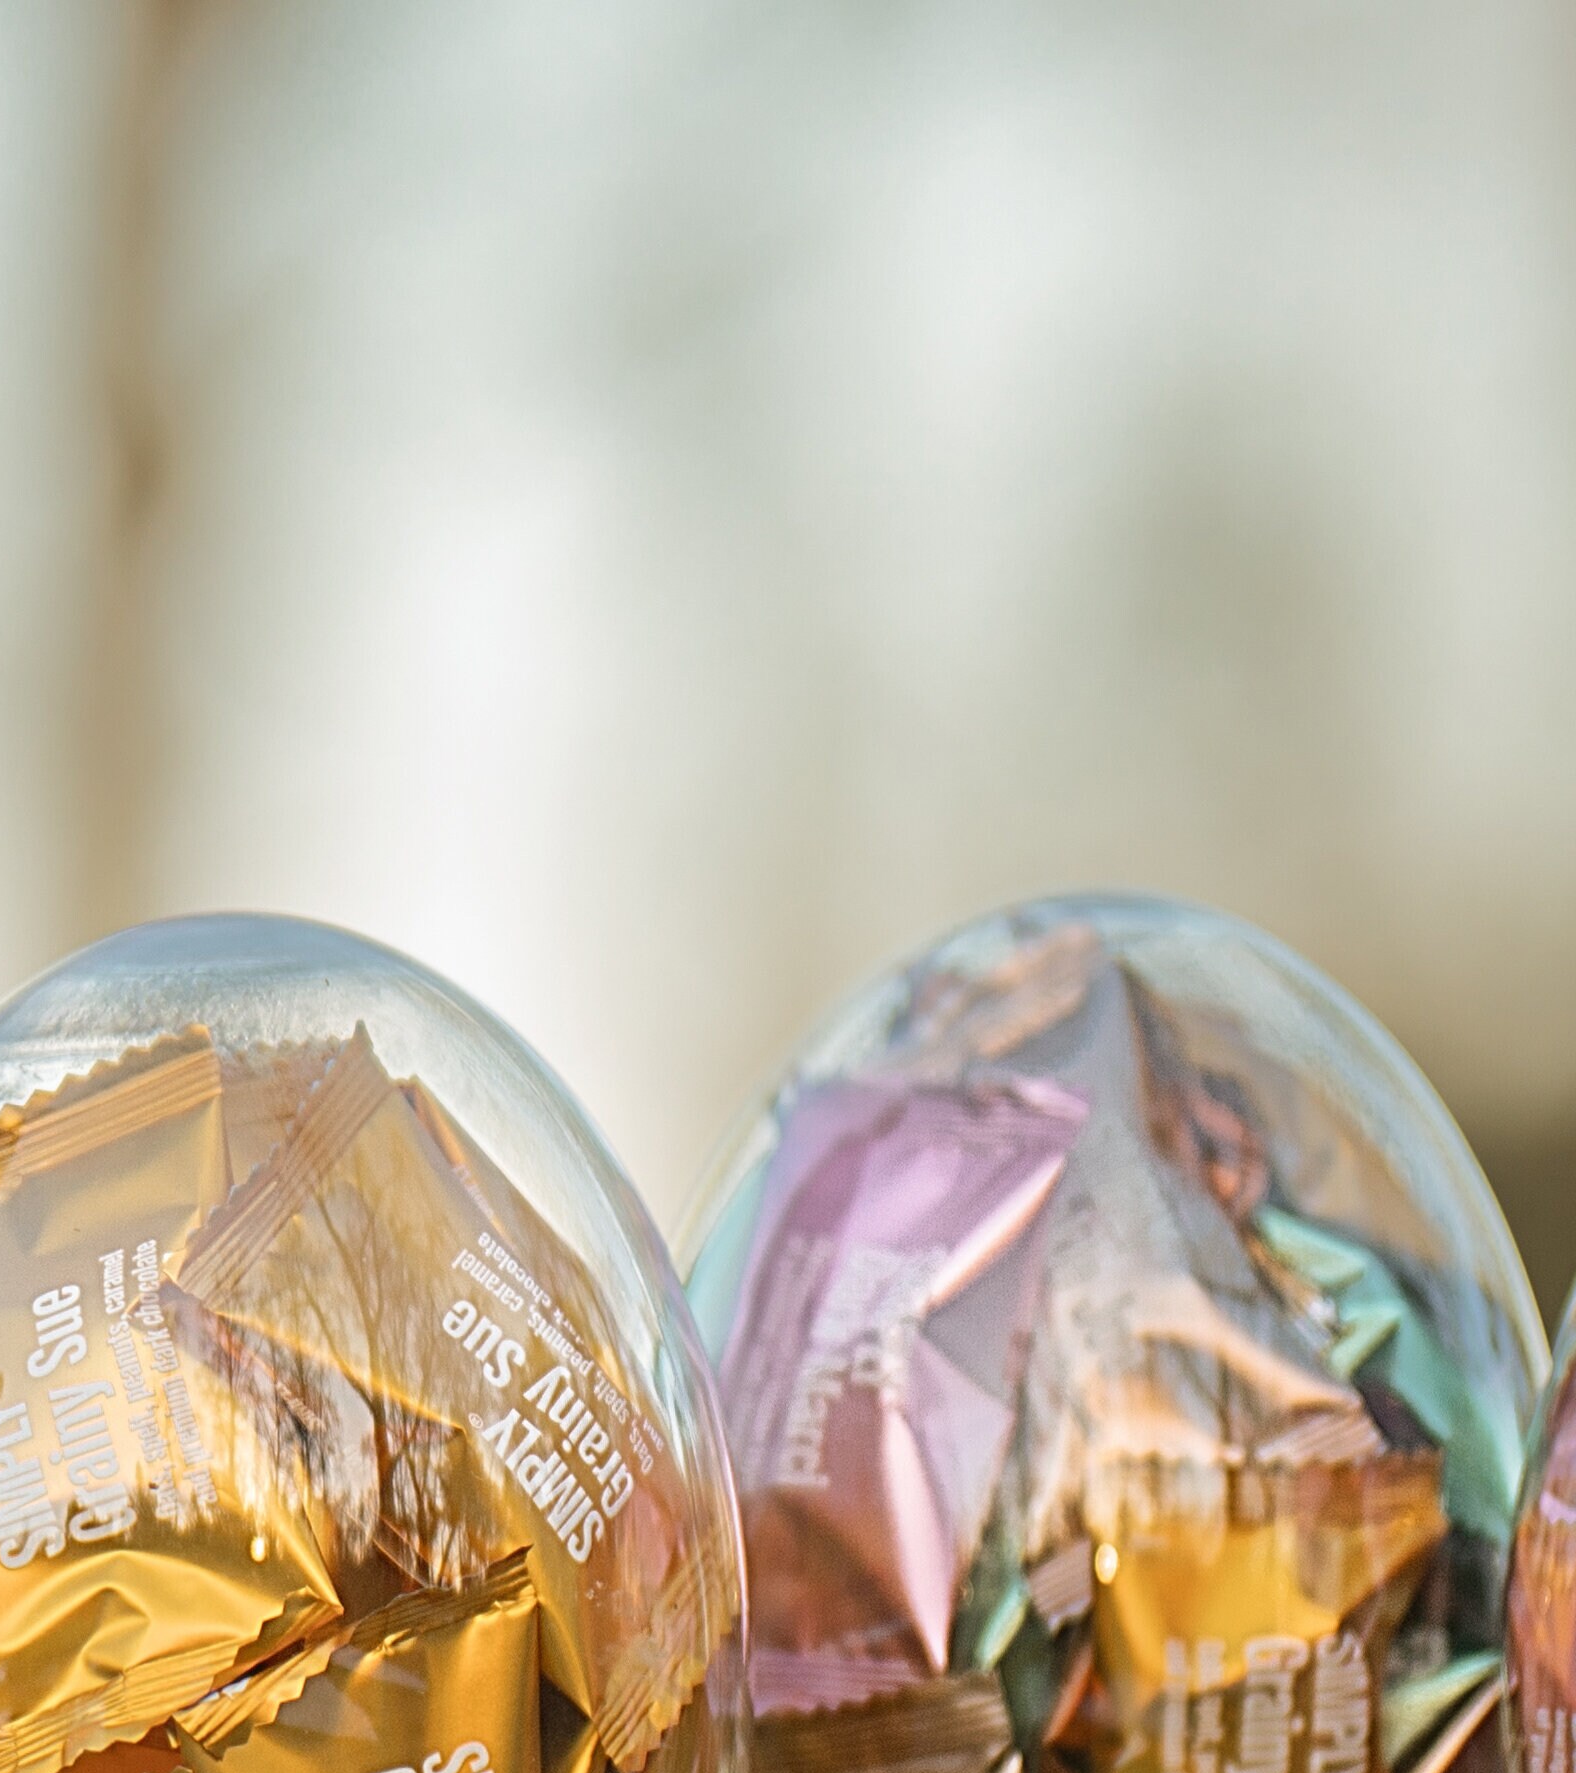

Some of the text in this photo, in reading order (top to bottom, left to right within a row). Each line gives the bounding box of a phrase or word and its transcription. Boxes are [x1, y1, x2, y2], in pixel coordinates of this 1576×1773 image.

[99, 1248, 126, 1314] caramel
[130, 1238, 164, 1326] chocolate
[451, 1248, 525, 1313] caramel
[143, 1328, 180, 1375] dark
[442, 1299, 526, 1388] Sue
[27, 1284, 137, 1543] Grainy Sue
[523, 1365, 635, 1519] Grainy
